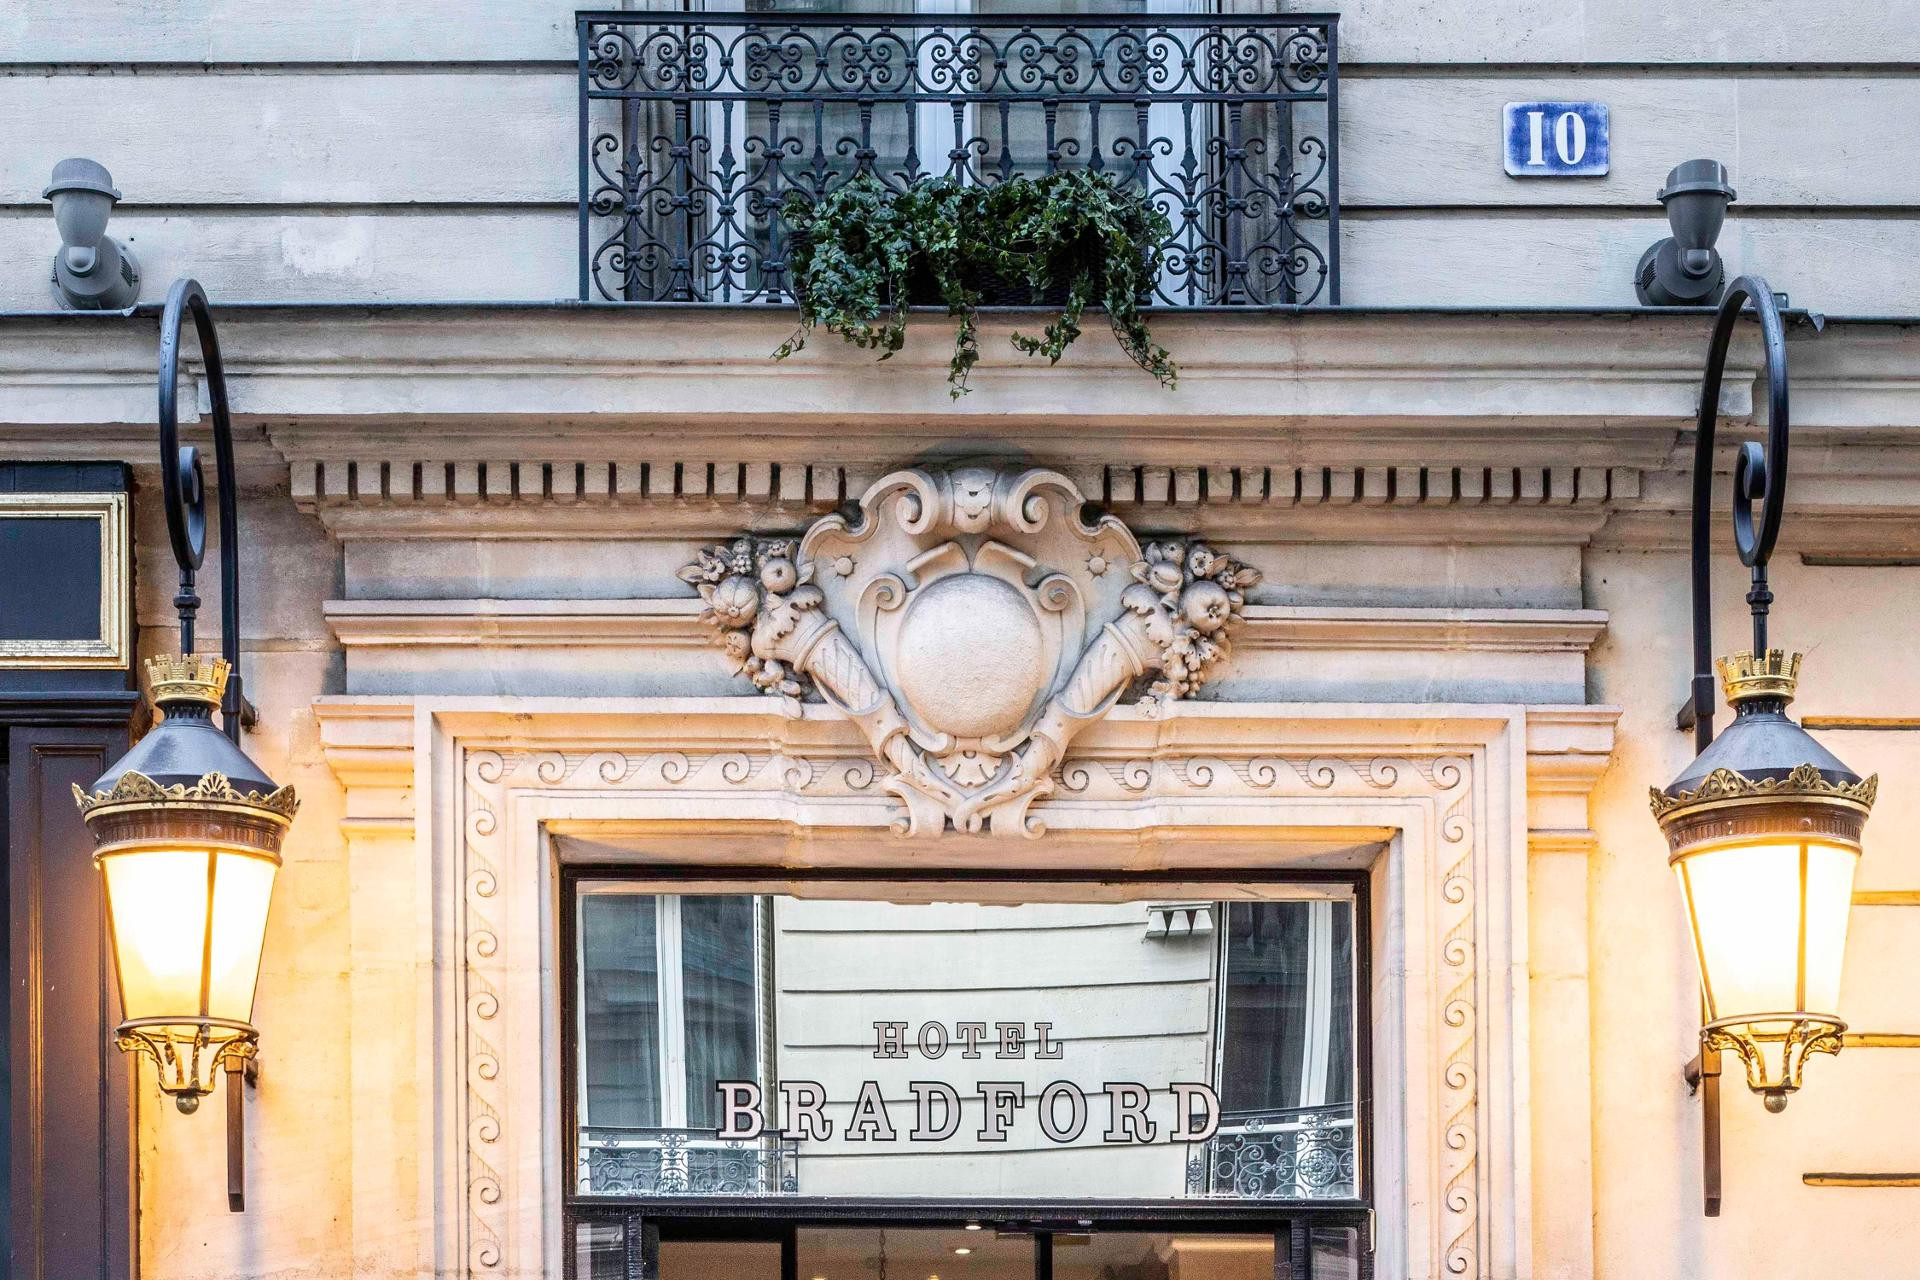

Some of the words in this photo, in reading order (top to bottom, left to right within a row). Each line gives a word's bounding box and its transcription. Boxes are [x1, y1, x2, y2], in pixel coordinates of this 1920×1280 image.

[1527, 111, 1587, 166] 10
[873, 1021, 1063, 1059] HOTEL
[715, 1080, 1222, 1143] BRADFORD
